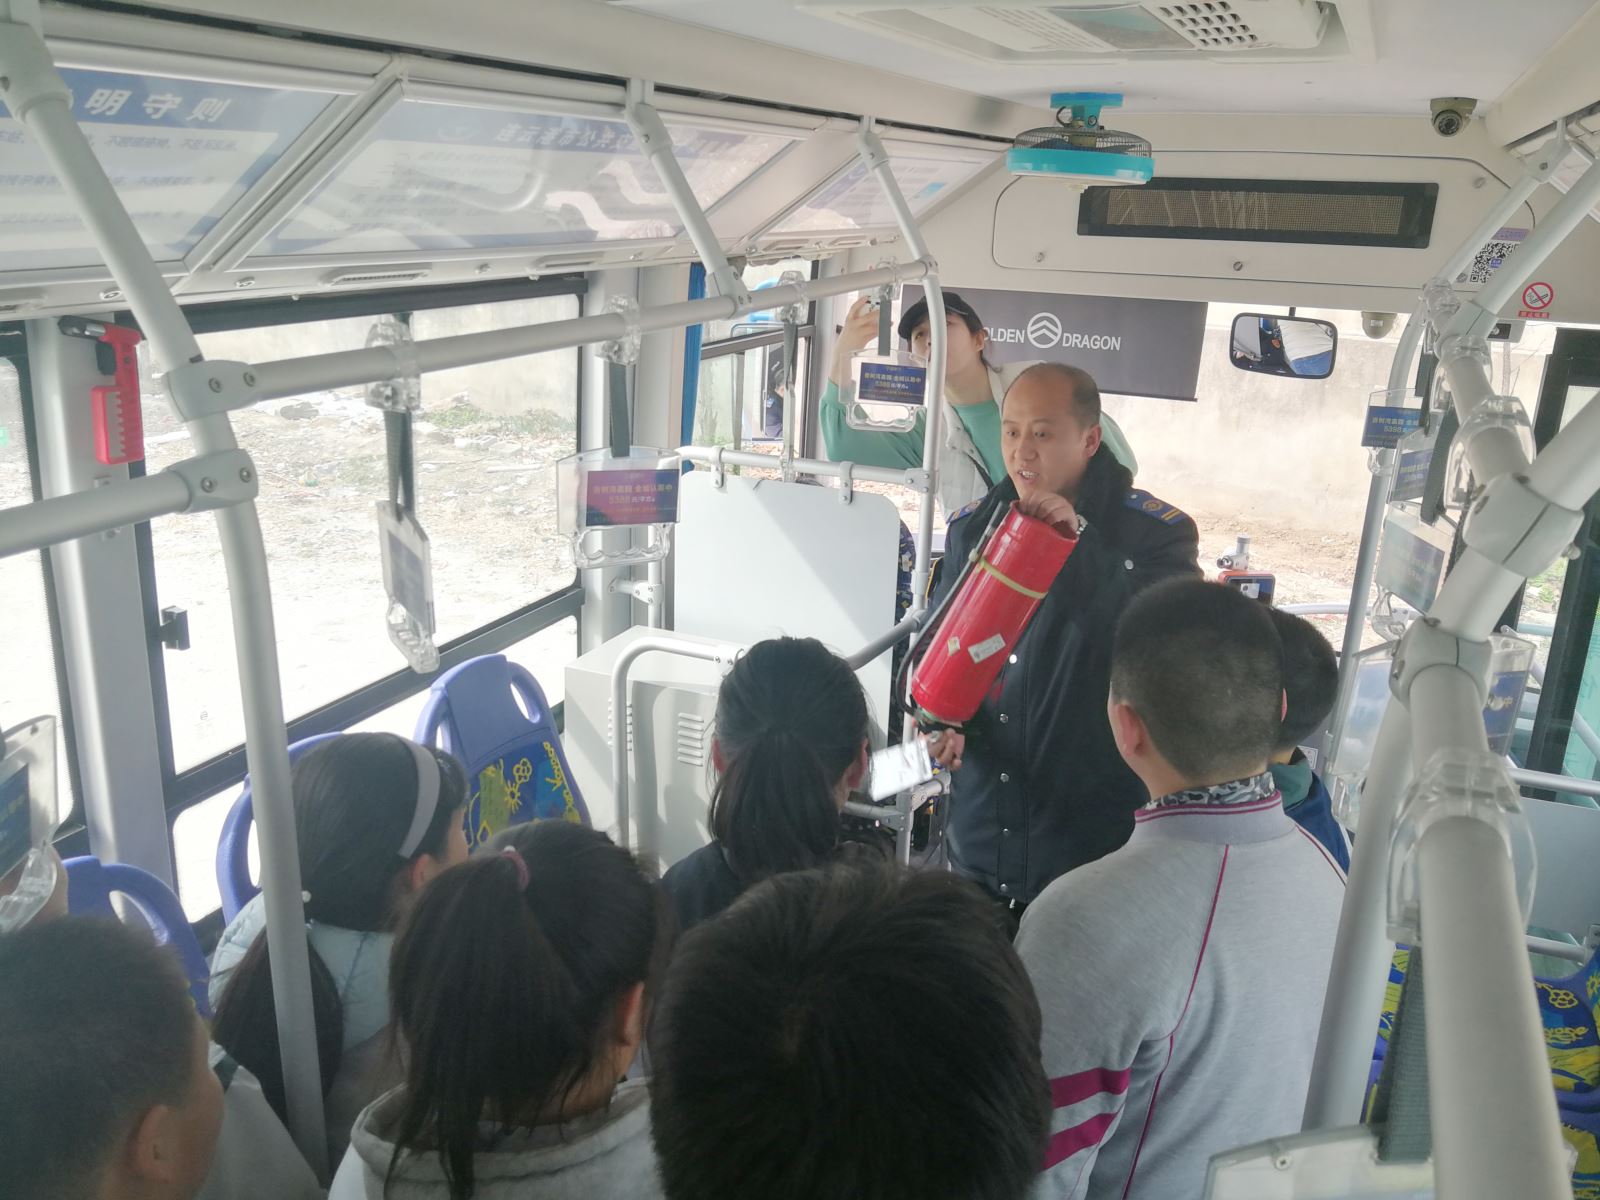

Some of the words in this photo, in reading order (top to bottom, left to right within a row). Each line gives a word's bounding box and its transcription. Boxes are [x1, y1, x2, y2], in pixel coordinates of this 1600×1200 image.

[69, 89, 231, 123] 明守则
[983, 326, 1026, 345] OLDEN
[1062, 333, 1122, 352] DRAGON
